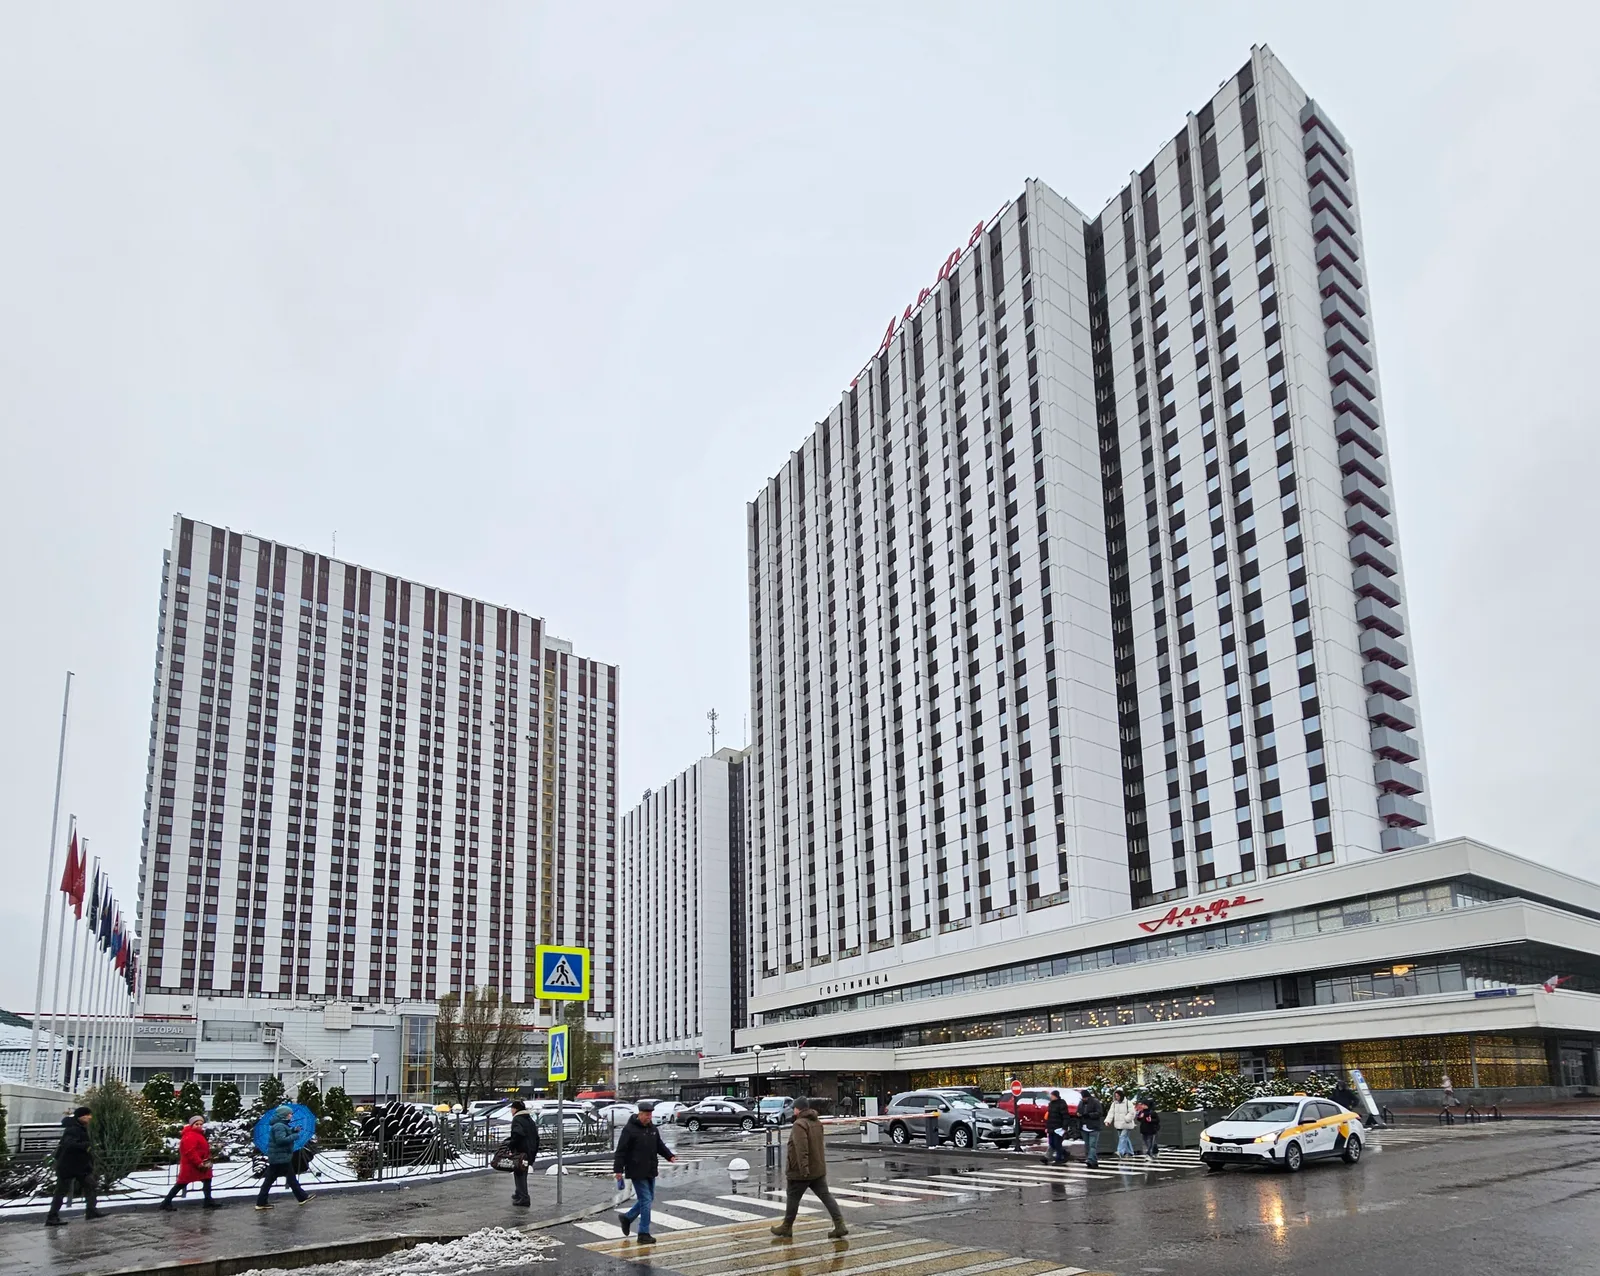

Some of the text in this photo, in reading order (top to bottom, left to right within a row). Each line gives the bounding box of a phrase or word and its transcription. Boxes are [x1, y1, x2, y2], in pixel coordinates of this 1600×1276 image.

[1140, 895, 1263, 932] Альфа
[819, 974, 888, 996] ГОСТИНИЦА
[137, 1026, 185, 1035] РЕСТОРАН
